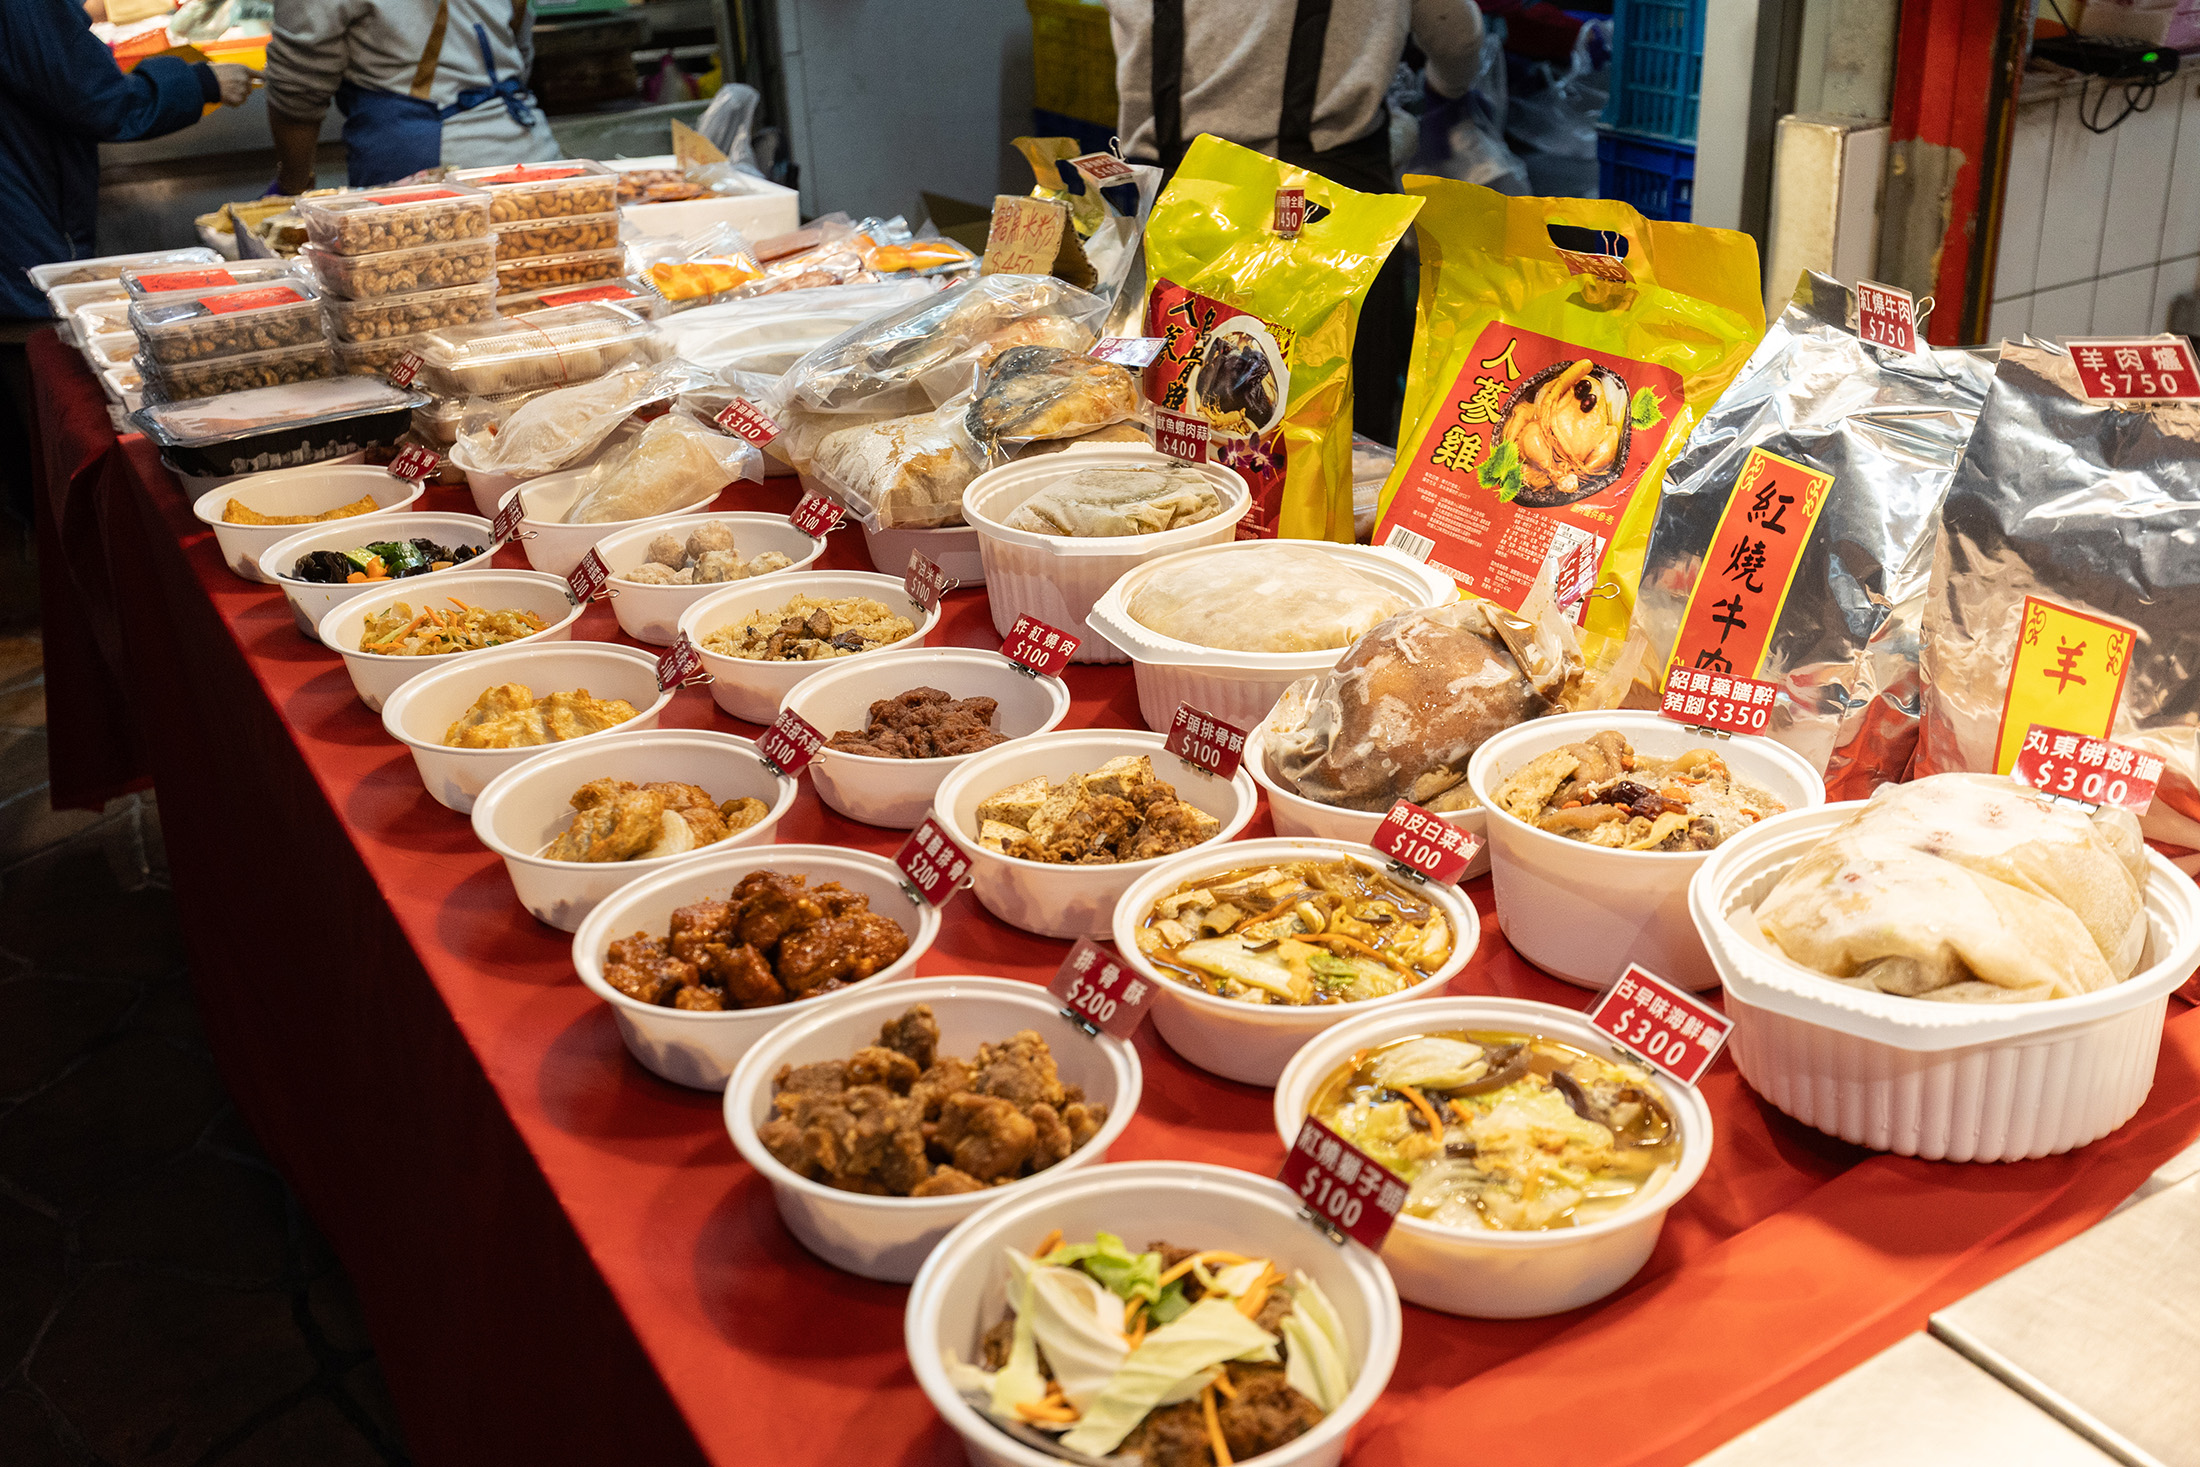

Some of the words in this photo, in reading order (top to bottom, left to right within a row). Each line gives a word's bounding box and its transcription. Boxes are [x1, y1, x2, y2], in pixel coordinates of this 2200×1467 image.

[1860, 287, 1912, 325] 紅燒牛肉
[1869, 316, 1906, 347] $750
[2080, 347, 2184, 372] 羊肉爐
[2100, 372, 2178, 396] $750
[722, 412, 761, 439] $300
[1156, 415, 1208, 441] 魷魚螺肉蒜
[1163, 434, 1197, 459] $400
[395, 460, 419, 478] $100
[796, 509, 820, 531] $100
[570, 569, 590, 598] $200
[910, 576, 931, 603] $100
[1559, 557, 1577, 600] $450
[1012, 639, 1050, 668] $100
[1013, 618, 1077, 657] 炸紅燒肉
[660, 655, 677, 683] $100
[2042, 634, 2088, 696] 羊
[1668, 669, 1776, 707] 紹興藥膳醉
[765, 733, 796, 765] $100
[774, 712, 822, 756] 綜合甜不辣
[1175, 707, 1245, 755] 芋頭排骨酥
[1181, 734, 1221, 768] $100
[2023, 729, 2165, 784] 丸東佛跳牆
[2034, 760, 2129, 804] $300
[915, 823, 967, 882] 糖醋排骨
[1387, 805, 1480, 861] 魚皮白菜滷
[1390, 831, 1443, 870] $100
[906, 850, 940, 892] $200
[1073, 947, 1148, 1007] 排骨酥
[1065, 976, 1117, 1023] $200
[1616, 978, 1723, 1053] 古早味海鮮羹
[1612, 1007, 1687, 1067] $300
[1296, 1121, 1407, 1218] 紅燒獅子頭
[1299, 1165, 1364, 1229] $100
